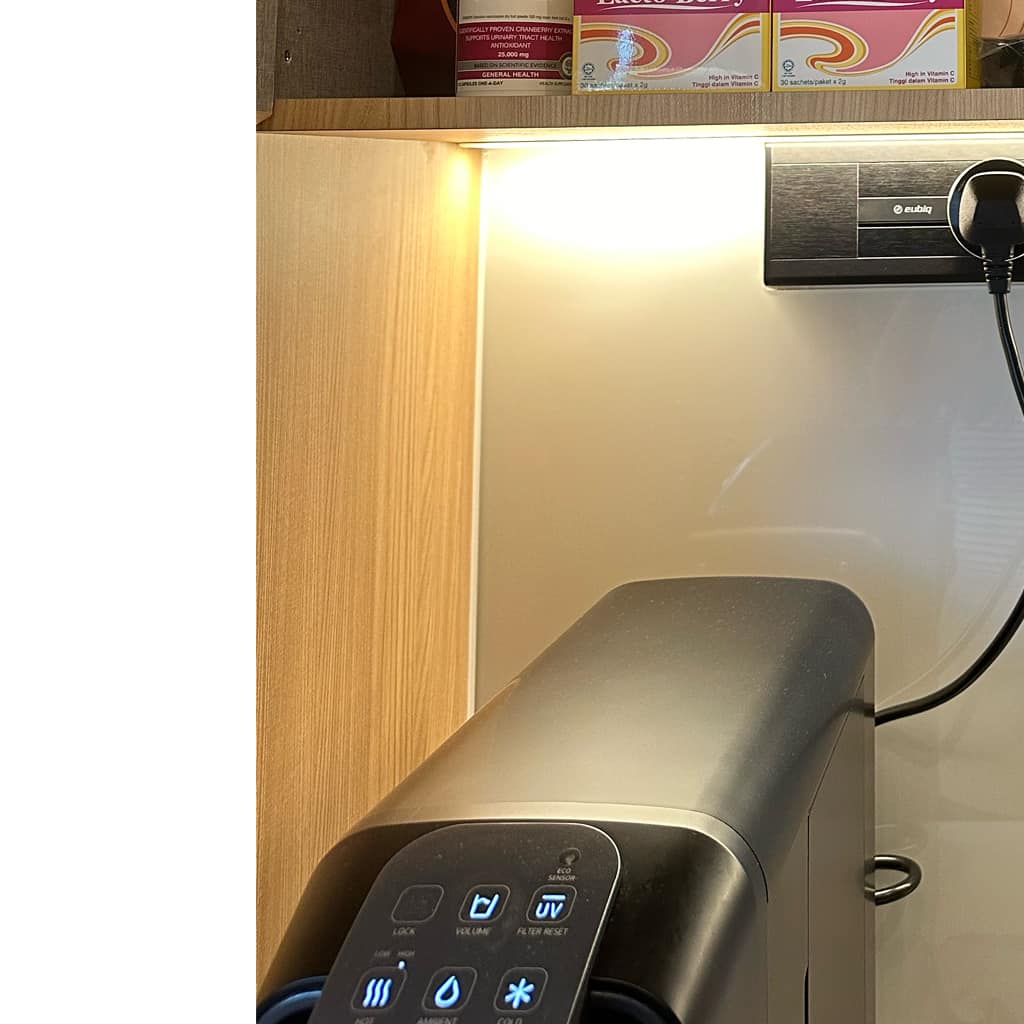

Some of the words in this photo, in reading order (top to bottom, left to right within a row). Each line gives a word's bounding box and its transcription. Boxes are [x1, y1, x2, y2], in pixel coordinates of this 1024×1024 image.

[904, 204, 933, 215] eubiq
[535, 902, 564, 919] UV
[392, 928, 416, 936] LOCK
[455, 927, 492, 936] VOLUME
[516, 927, 542, 936] FILTER
[543, 927, 569, 936] RESET
[397, 950, 415, 958] HIGH
